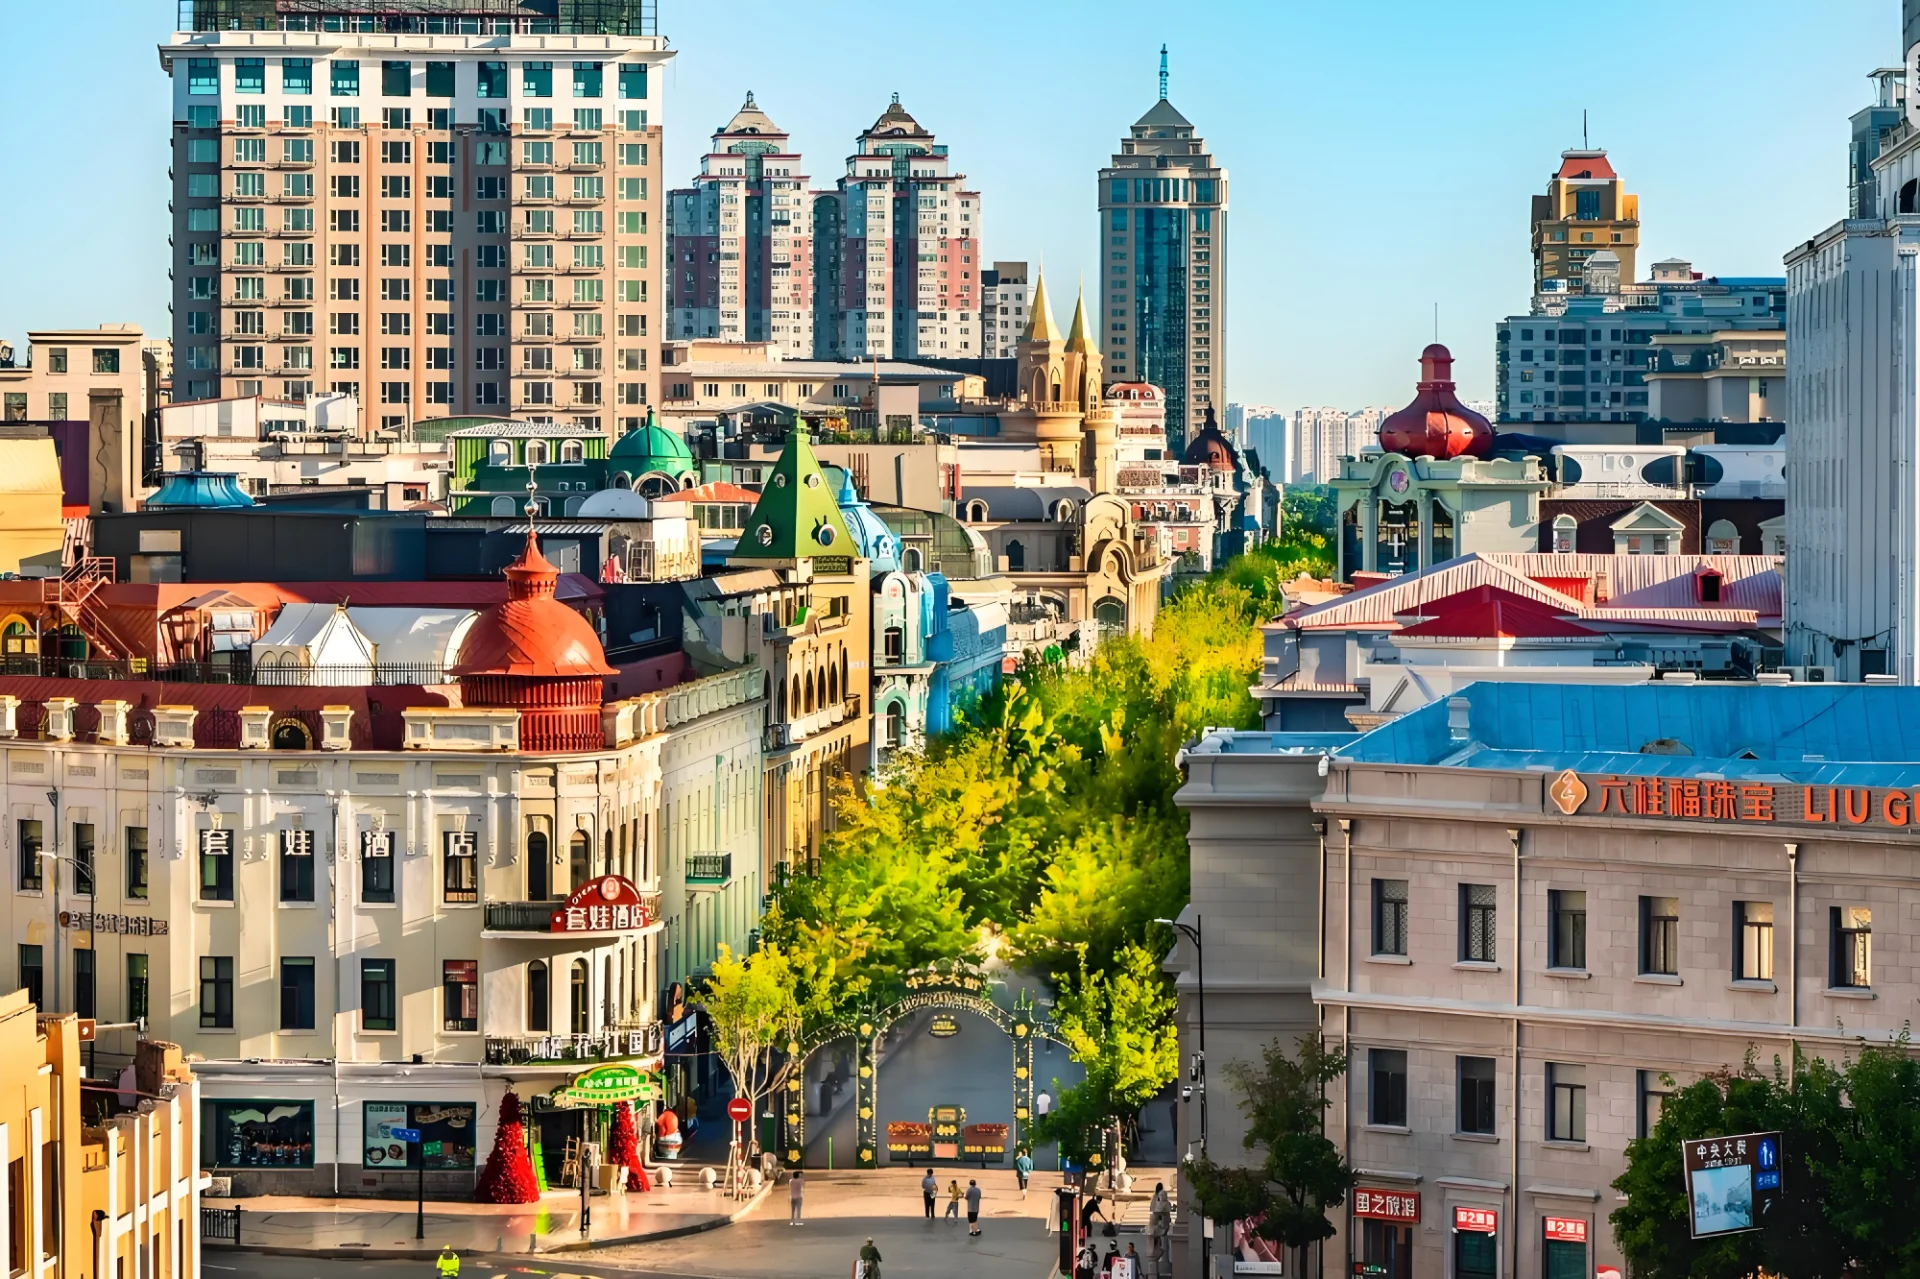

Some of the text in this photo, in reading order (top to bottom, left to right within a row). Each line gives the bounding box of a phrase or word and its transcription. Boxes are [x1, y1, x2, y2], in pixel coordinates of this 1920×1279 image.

[1597, 776, 1773, 821] 六桂福珠宝
[1883, 789, 1920, 826] G
[202, 829, 475, 858] 套娃酒店
[565, 904, 644, 930] 套娃酒店
